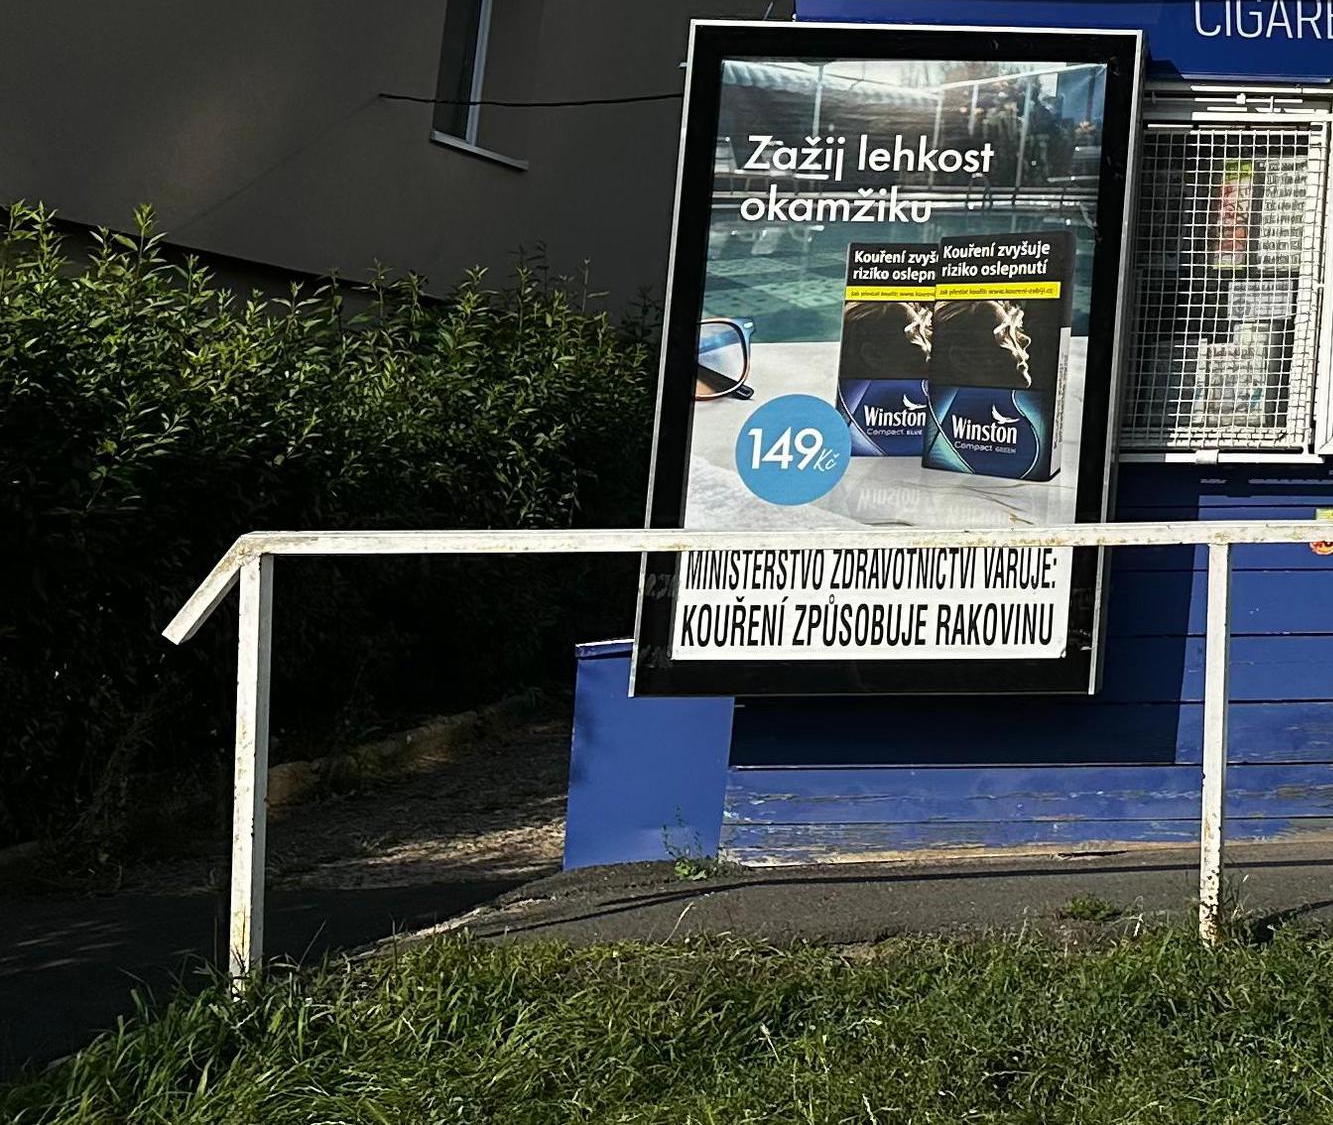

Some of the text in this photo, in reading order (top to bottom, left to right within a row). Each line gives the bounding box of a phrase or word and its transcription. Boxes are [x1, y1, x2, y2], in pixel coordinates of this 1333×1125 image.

[743, 134, 995, 182] Zažij lehkost
[740, 184, 932, 224] okamžiku
[854, 249, 906, 264] Kouření
[942, 239, 1051, 262] Kouření zvyšuje
[853, 266, 936, 284] riziko oslepn
[941, 259, 1048, 279] riziko oslepnutí
[863, 404, 926, 427] Winston
[866, 427, 904, 437] Compact
[951, 413, 1018, 445] Winston
[748, 427, 824, 471] 149
[954, 439, 993, 453] Compact
[685, 549, 825, 591] MINISTERSTVO
[984, 547, 1058, 589] VARUJE:
[680, 594, 1055, 648] KOUŘENÍ ZPŮSOBUJE RAKOVINU
